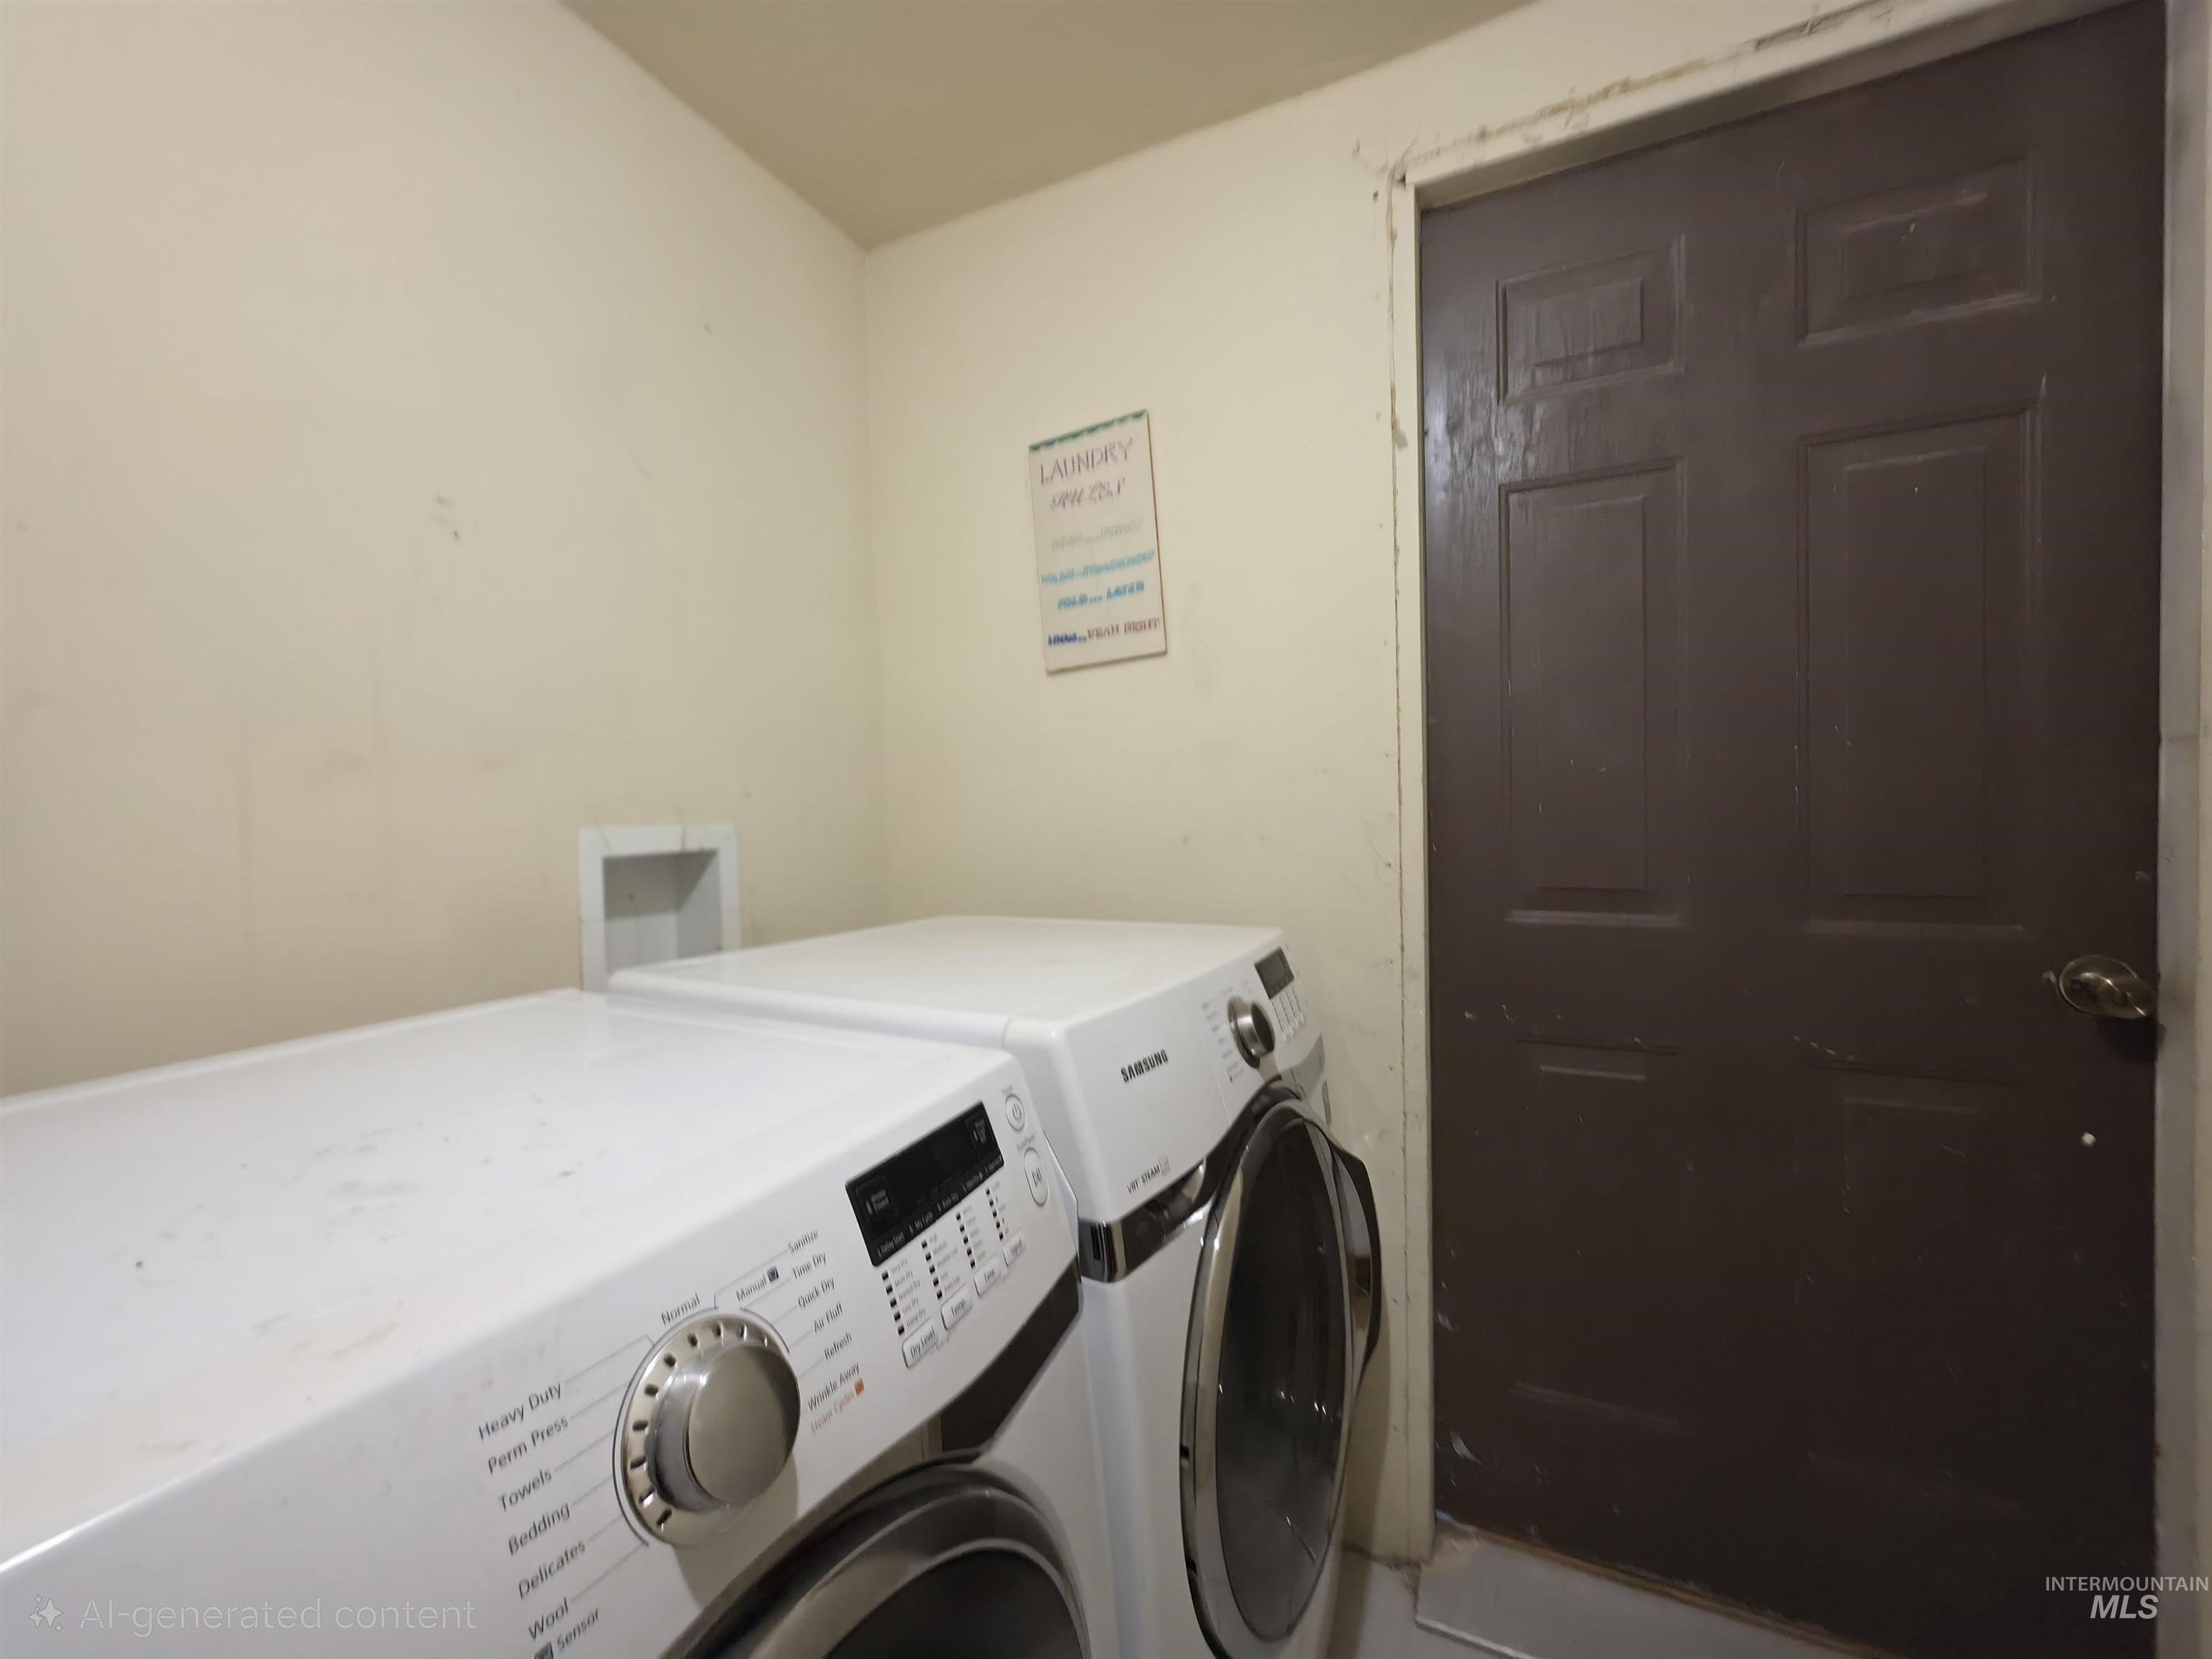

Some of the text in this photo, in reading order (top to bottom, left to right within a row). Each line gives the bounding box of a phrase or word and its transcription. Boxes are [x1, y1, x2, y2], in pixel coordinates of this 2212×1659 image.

[1041, 438, 1133, 484] LAUNDRY
[1120, 1048, 1168, 1082] SAMSUNG
[788, 1230, 819, 1254] Sanitize
[792, 1252, 827, 1280] Time Dry
[736, 1274, 768, 1303] Manual
[798, 1277, 835, 1310] Quick Dry
[660, 1294, 701, 1326] Normal
[814, 1302, 843, 1334] Air Fluff
[824, 1331, 853, 1360] Refresh
[910, 1326, 935, 1359] Dry Level
[807, 1362, 860, 1411] Wrinkle Away
[478, 1382, 562, 1441] Heavy Duty
[487, 1418, 568, 1475] Perm Press
[499, 1469, 552, 1511] Towels
[508, 1503, 570, 1556] Bedding
[518, 1542, 586, 1599] Delicates
[529, 1596, 569, 1640] Wool
[557, 1608, 599, 1650] Sensor
